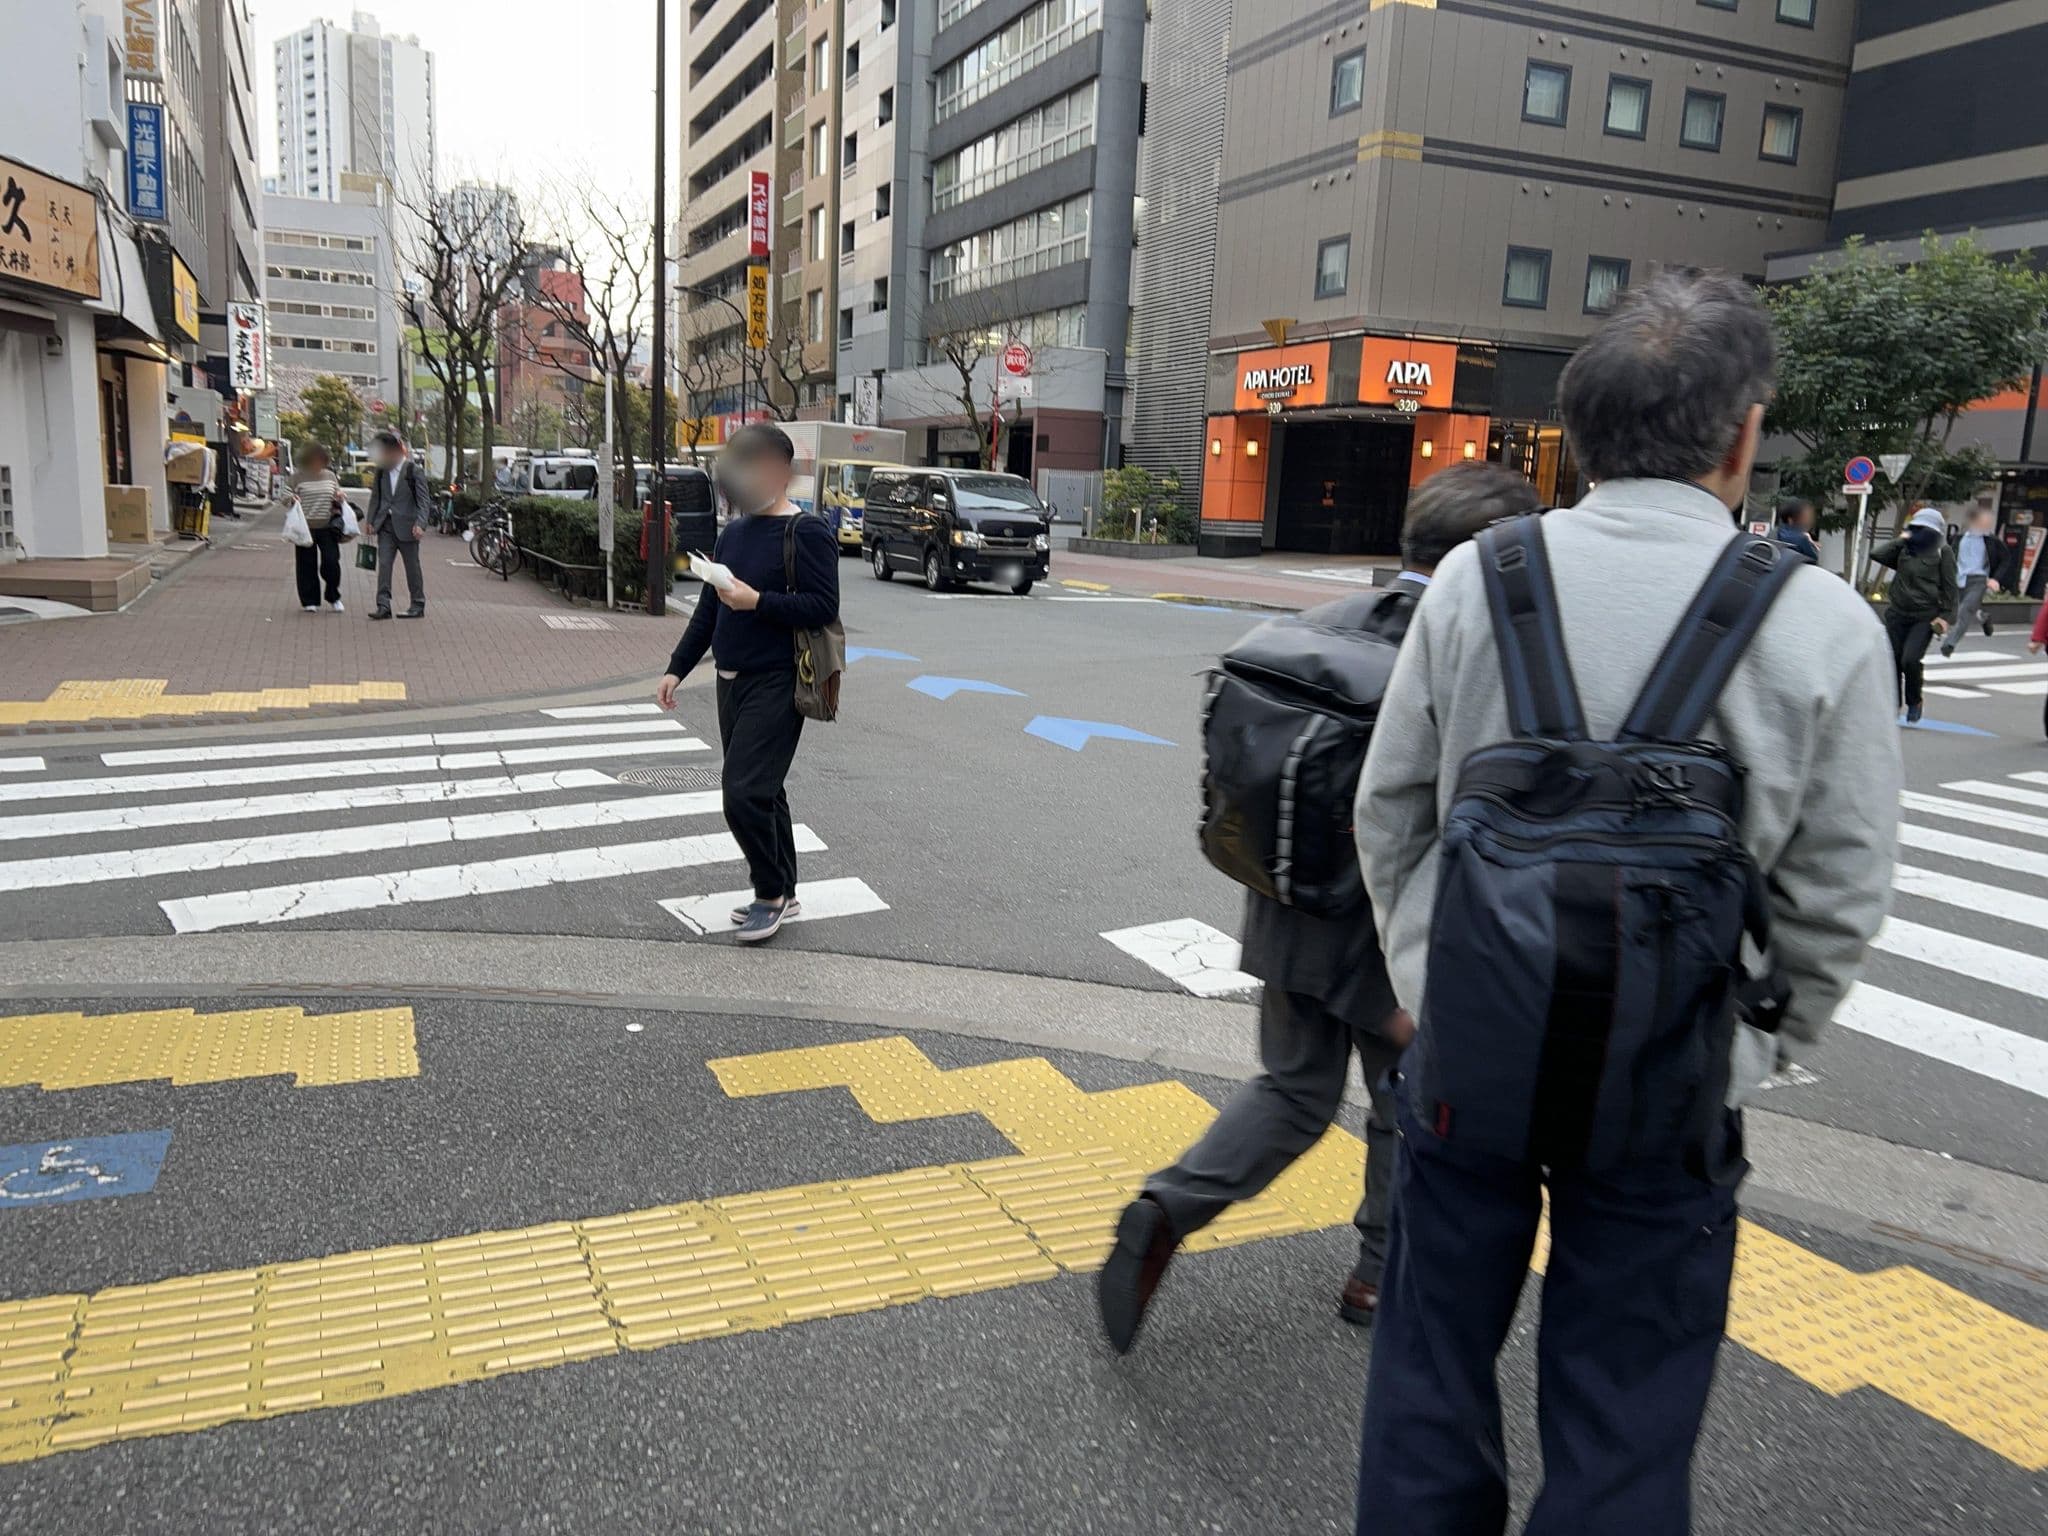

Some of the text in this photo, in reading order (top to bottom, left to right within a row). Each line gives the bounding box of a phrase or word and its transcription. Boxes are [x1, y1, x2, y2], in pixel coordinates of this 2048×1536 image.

[752, 183, 767, 242] スギ薬局
[752, 275, 767, 340] 処方せん
[1243, 364, 1313, 391] APA HOTEL
[1386, 360, 1433, 386] APA
[1398, 398, 1418, 412] 320
